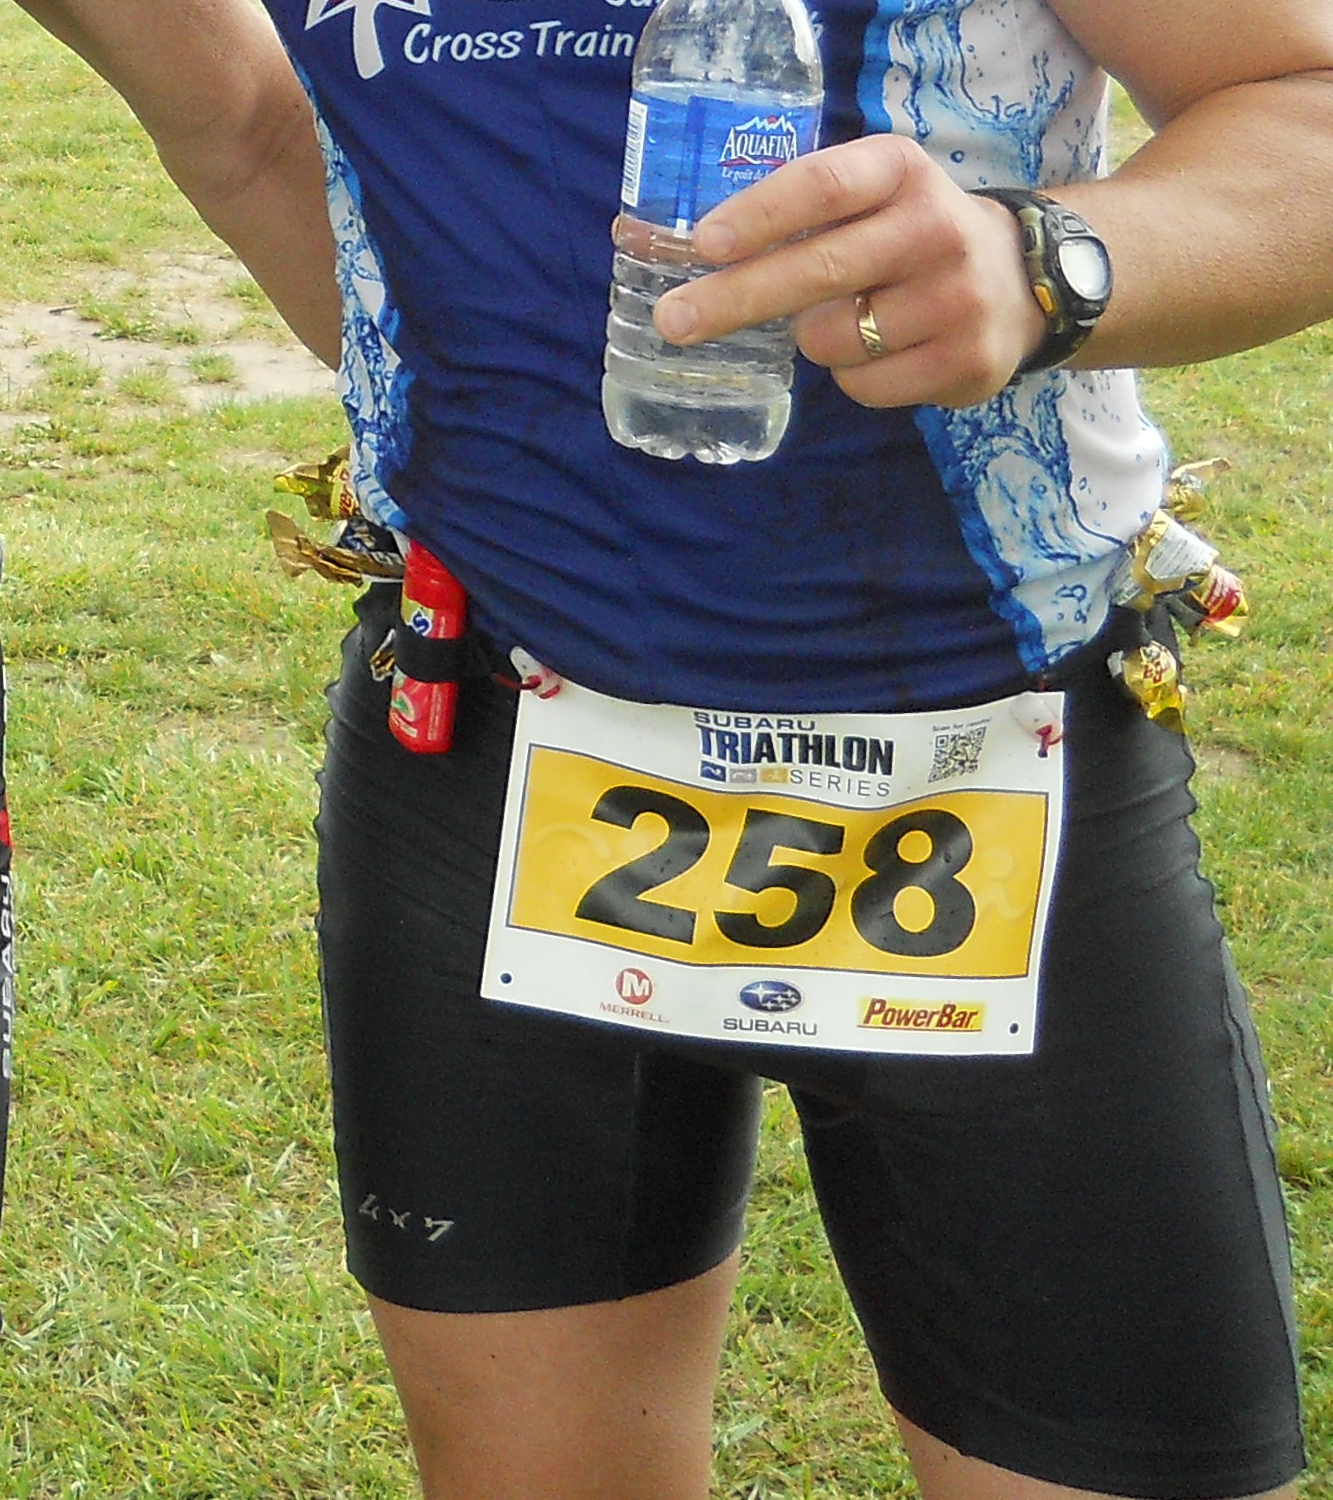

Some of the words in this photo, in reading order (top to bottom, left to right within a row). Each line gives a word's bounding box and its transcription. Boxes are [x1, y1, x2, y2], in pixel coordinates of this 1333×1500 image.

[404, 22, 524, 64] Cross
[719, 127, 797, 164] AQUAFINA
[693, 711, 816, 731] SUBARU
[695, 723, 894, 776] TRIATHLON
[789, 769, 891, 797] SERIES
[574, 786, 977, 958] 258
[599, 1002, 667, 1023] MERRELL
[723, 1017, 818, 1037] SUBARU
[864, 998, 977, 1030] PowerBar
